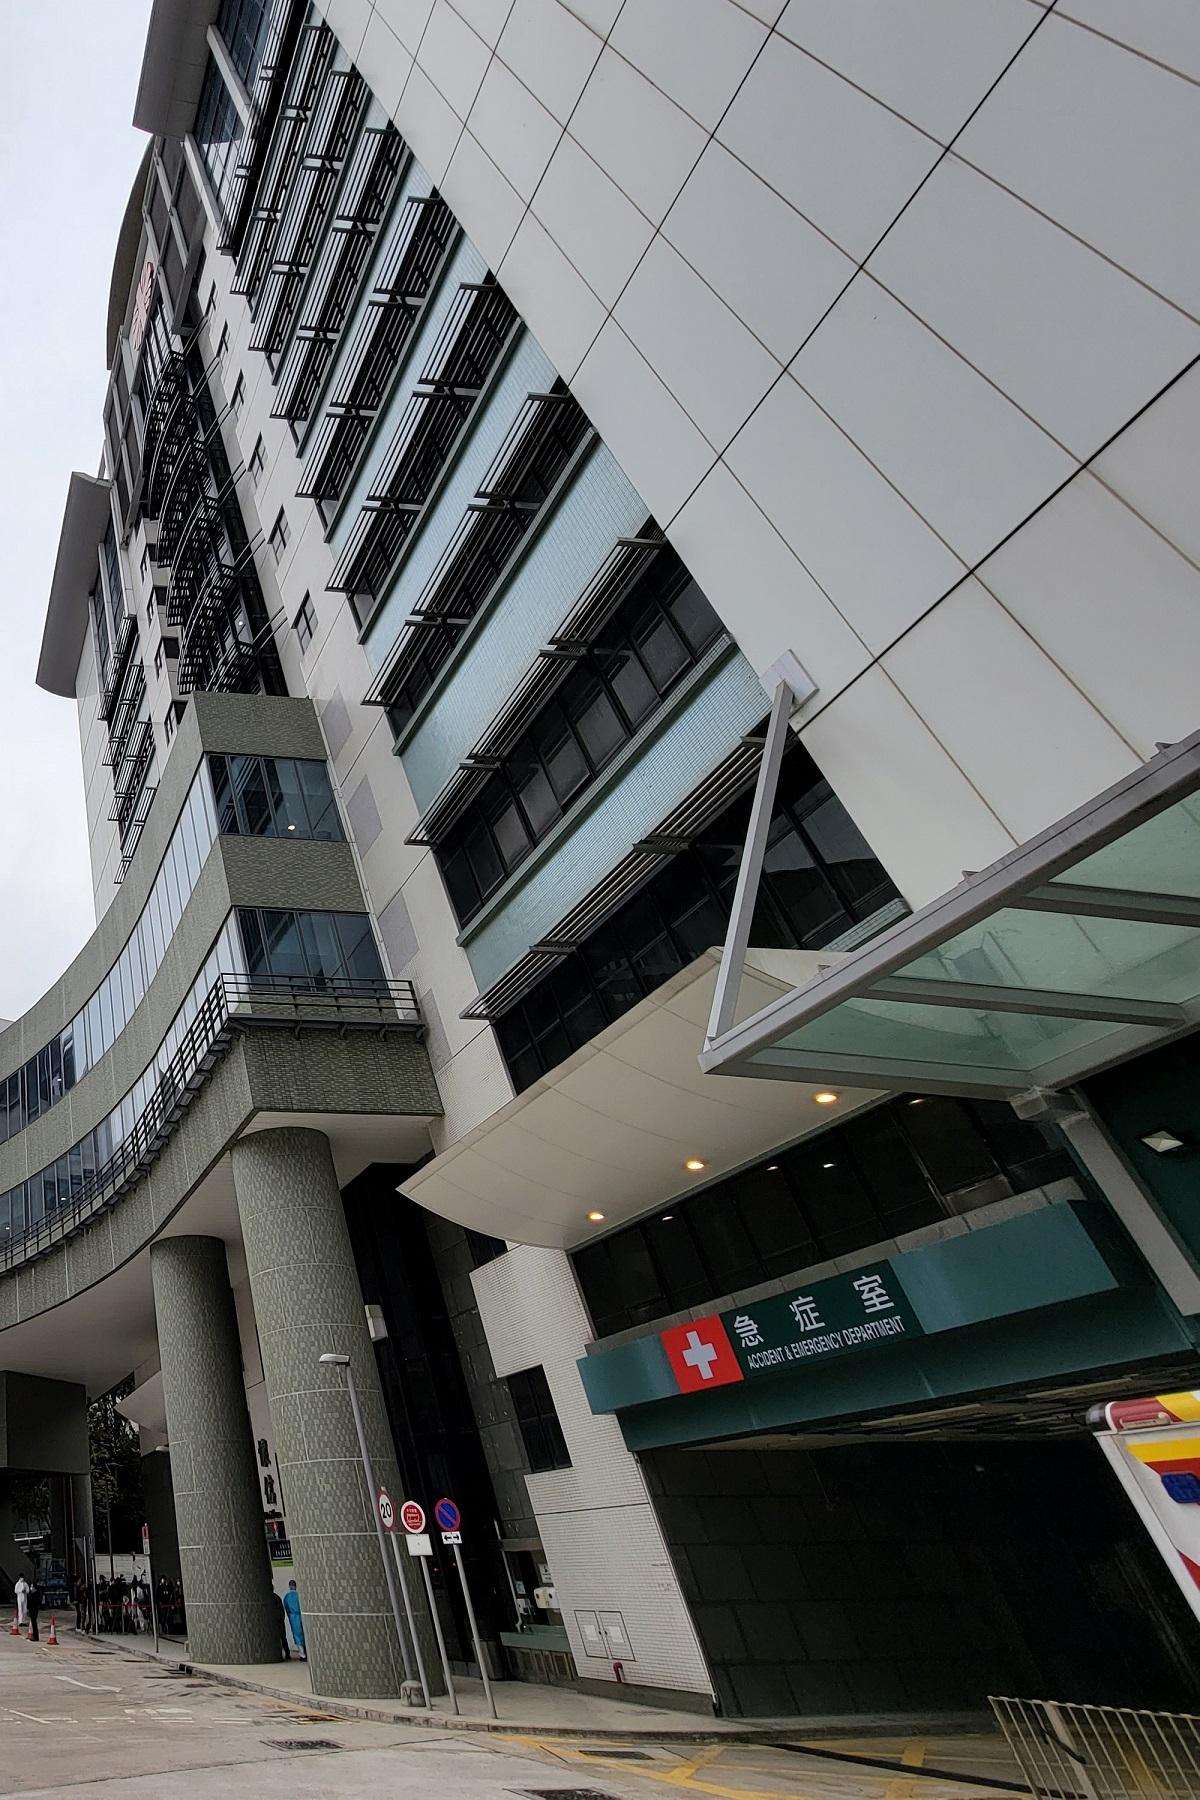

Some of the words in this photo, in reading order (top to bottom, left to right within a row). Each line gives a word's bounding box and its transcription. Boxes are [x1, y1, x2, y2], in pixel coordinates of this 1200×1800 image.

[733, 1274, 895, 1348] 急症室
[747, 1347, 787, 1369] ACCIDENT
[786, 1345, 794, 1361] &
[790, 1333, 845, 1359] EMERGENCY
[842, 1315, 906, 1346] DEPARTMENT
[380, 1502, 392, 1519] 20
